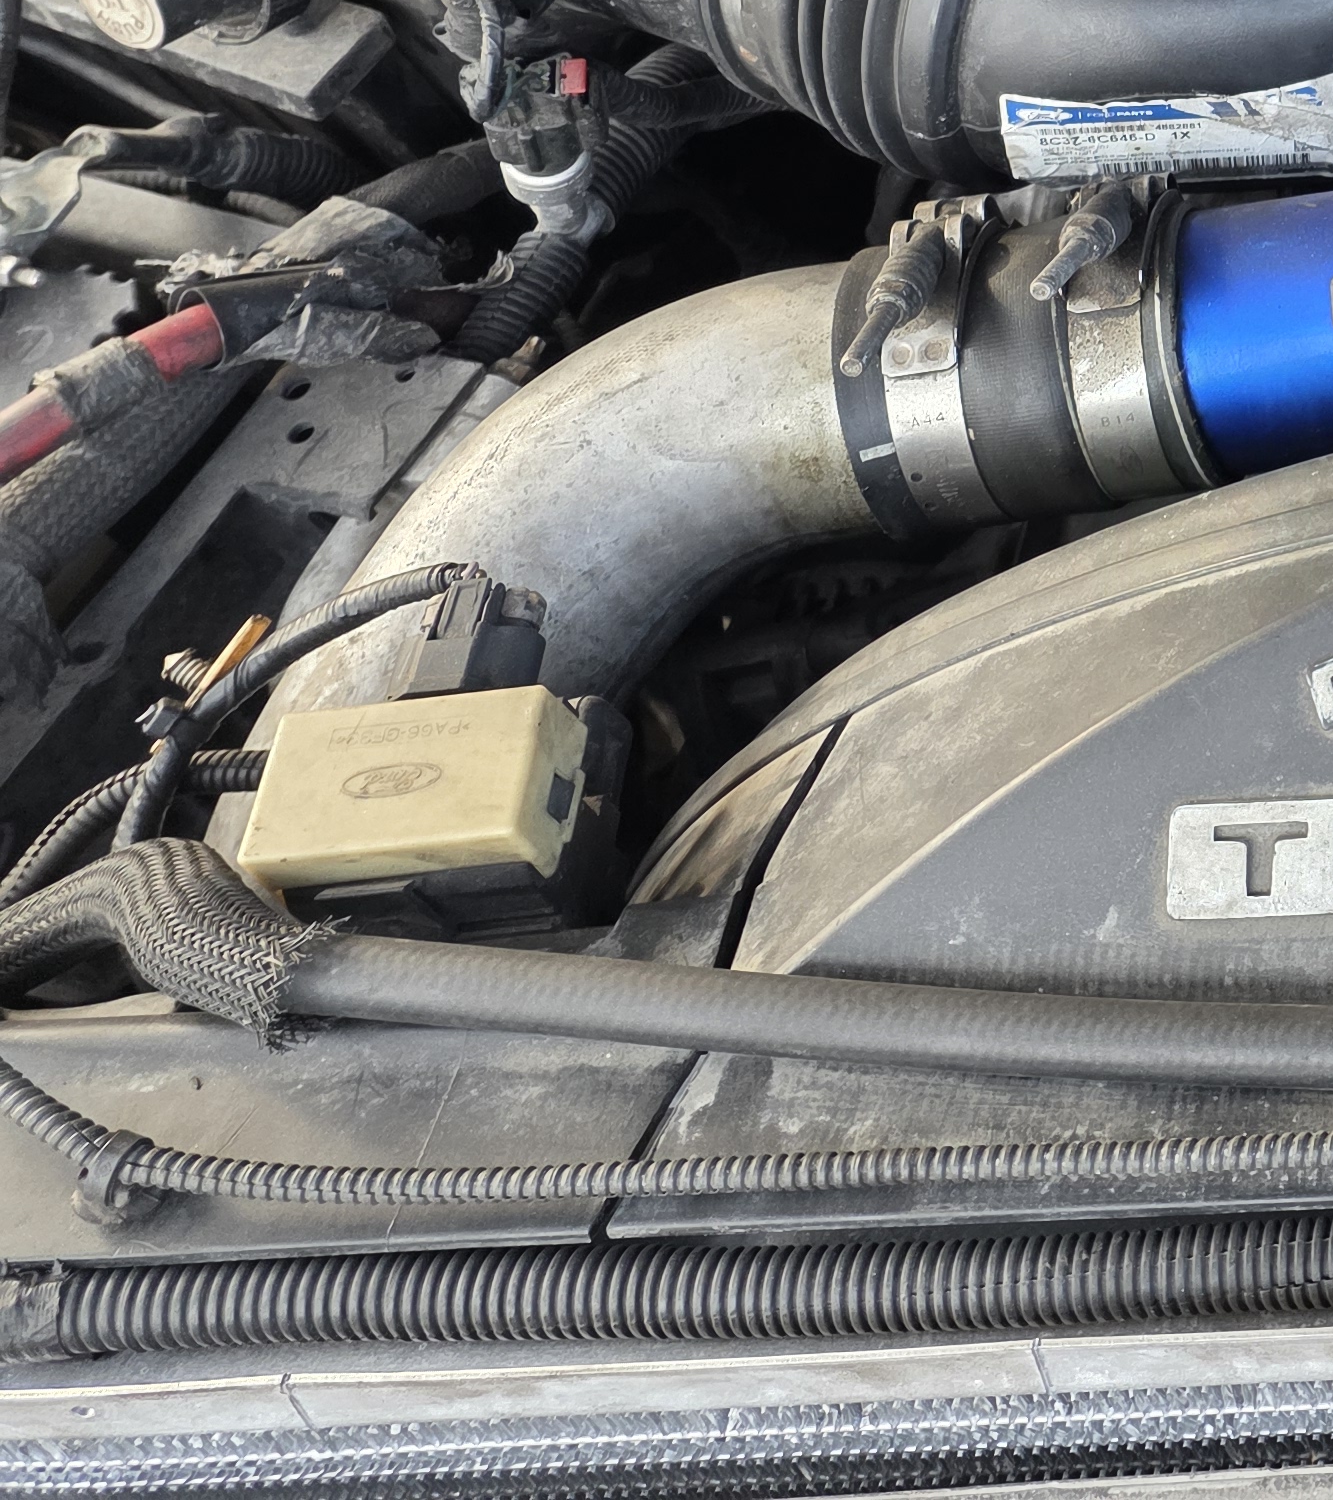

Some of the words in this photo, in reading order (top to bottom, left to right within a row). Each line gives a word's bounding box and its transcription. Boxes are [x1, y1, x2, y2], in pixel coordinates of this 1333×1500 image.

[96, 10, 145, 39] PUSH
[1171, 130, 1191, 140] 1X
[1101, 412, 1136, 428] B14
